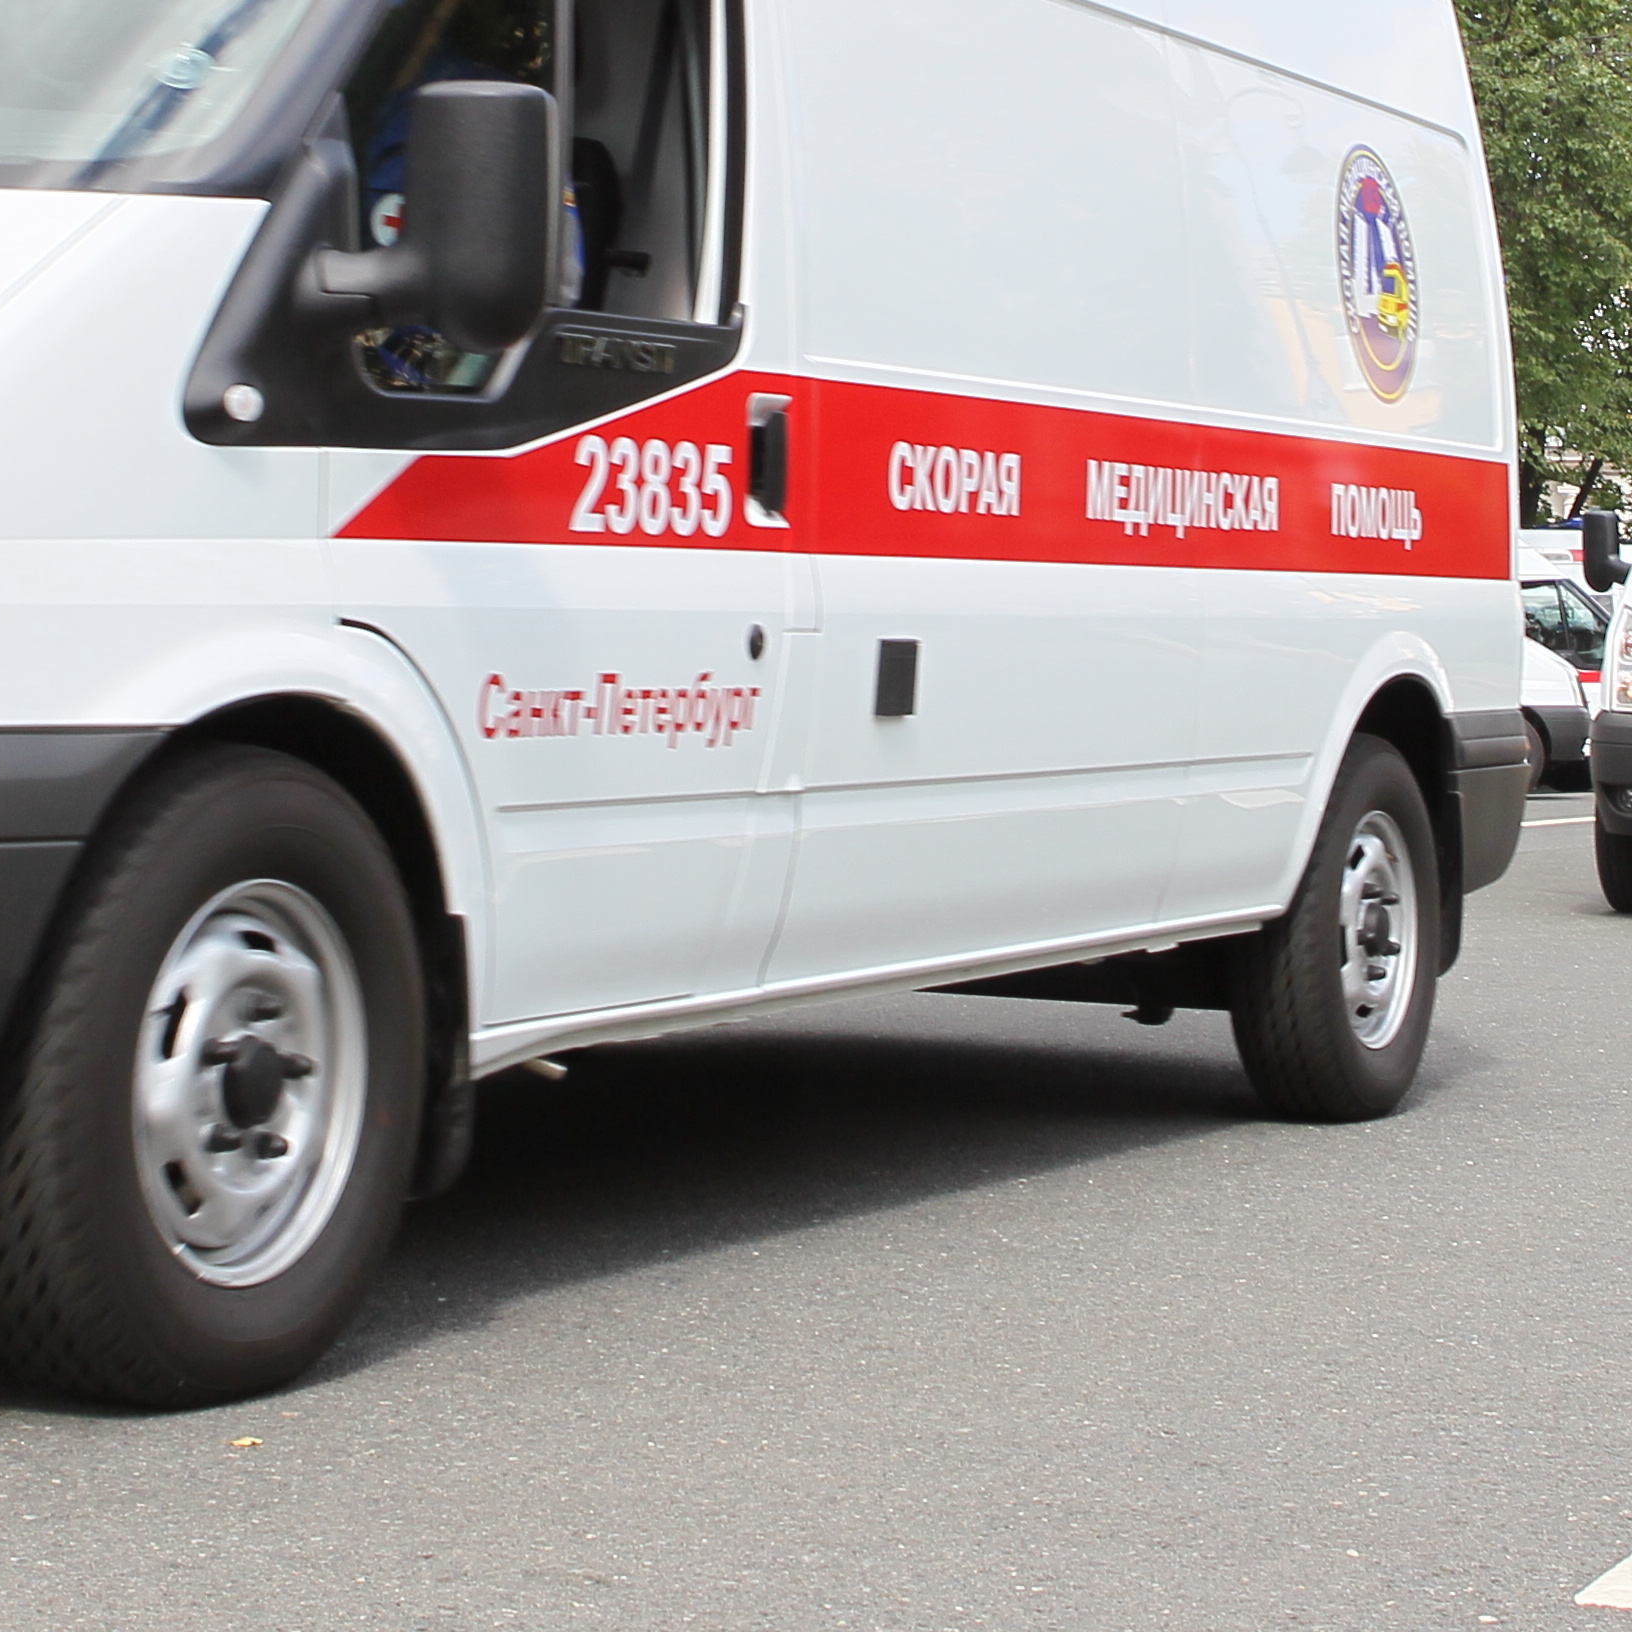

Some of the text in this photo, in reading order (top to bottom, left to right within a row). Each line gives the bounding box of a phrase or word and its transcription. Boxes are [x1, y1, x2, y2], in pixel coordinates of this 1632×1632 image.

[569, 433, 734, 538] 23835
[887, 440, 1423, 551] СКОРАЯ МЕДИЦИНСКАЯ ПОМОЩЬ
[475, 669, 763, 749] Санкт-Петербург
